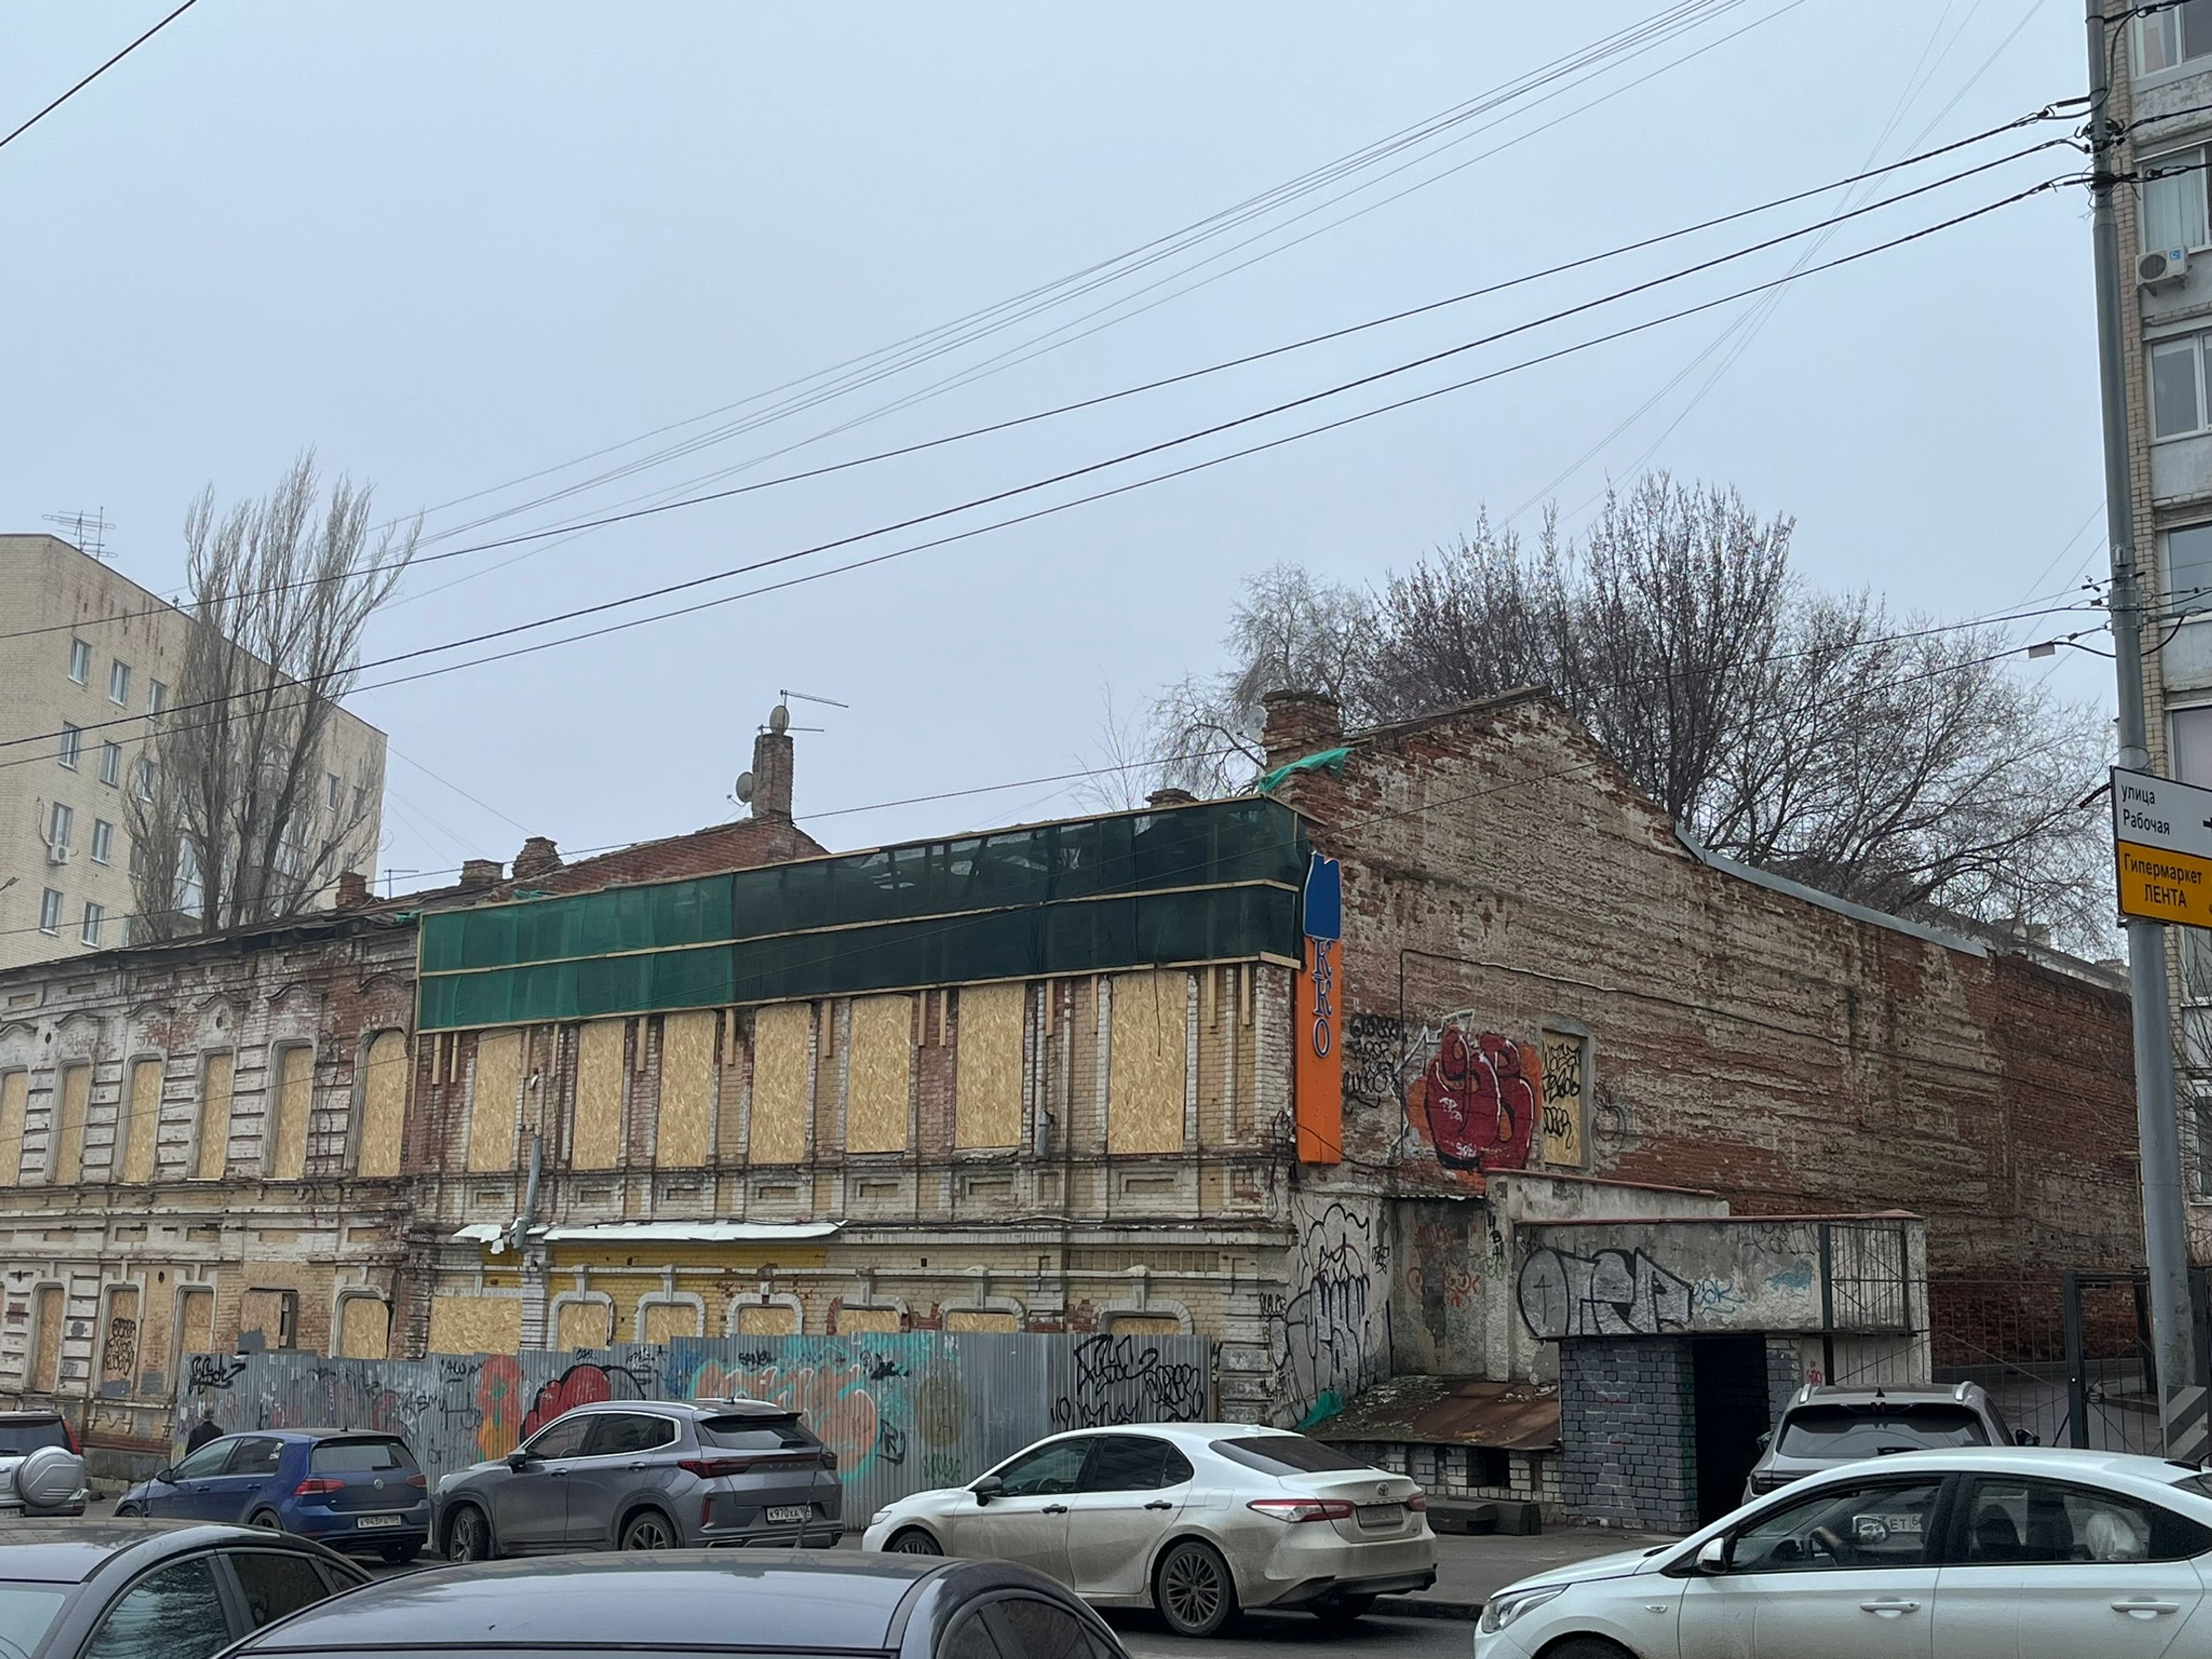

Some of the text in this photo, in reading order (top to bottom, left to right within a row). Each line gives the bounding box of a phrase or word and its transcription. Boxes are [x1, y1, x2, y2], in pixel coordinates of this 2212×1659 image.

[2121, 785, 2155, 805] улица
[2123, 809, 2170, 835] Рабочая
[2124, 853, 2202, 885] Гипермаркет
[2145, 884, 2187, 908] ЛЕНТА
